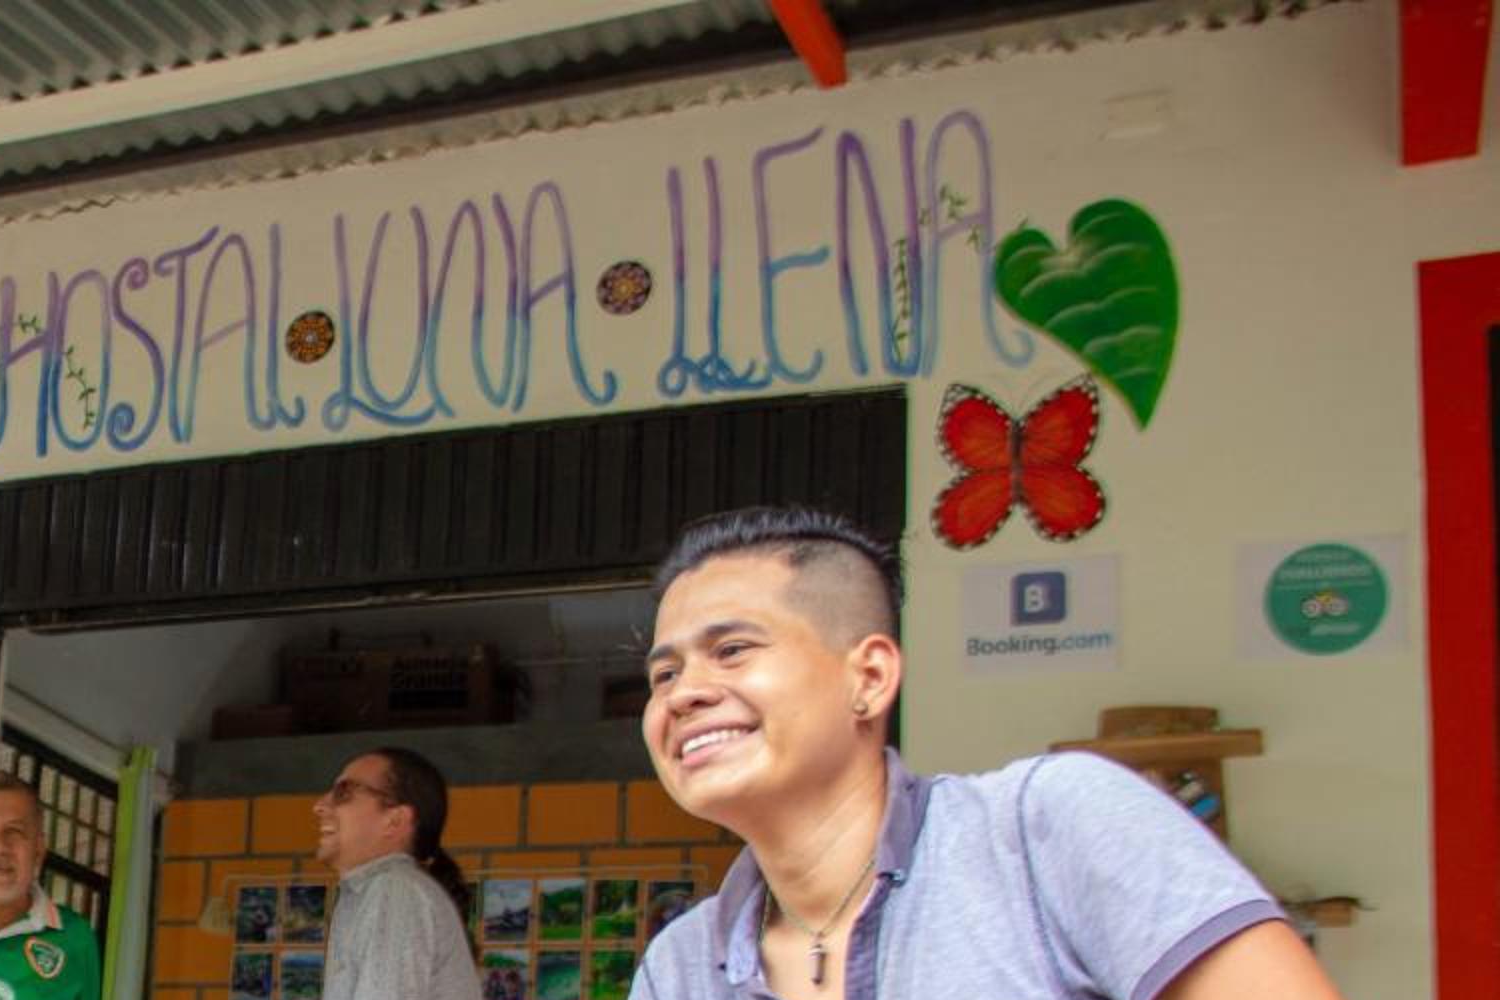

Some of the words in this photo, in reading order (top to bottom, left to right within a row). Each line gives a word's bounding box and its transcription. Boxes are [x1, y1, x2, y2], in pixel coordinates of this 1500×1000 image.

[321, 182, 617, 430] LUNA
[657, 108, 1035, 394] LLENA
[1024, 584, 1045, 614] B
[966, 632, 1113, 657] Booking.com
